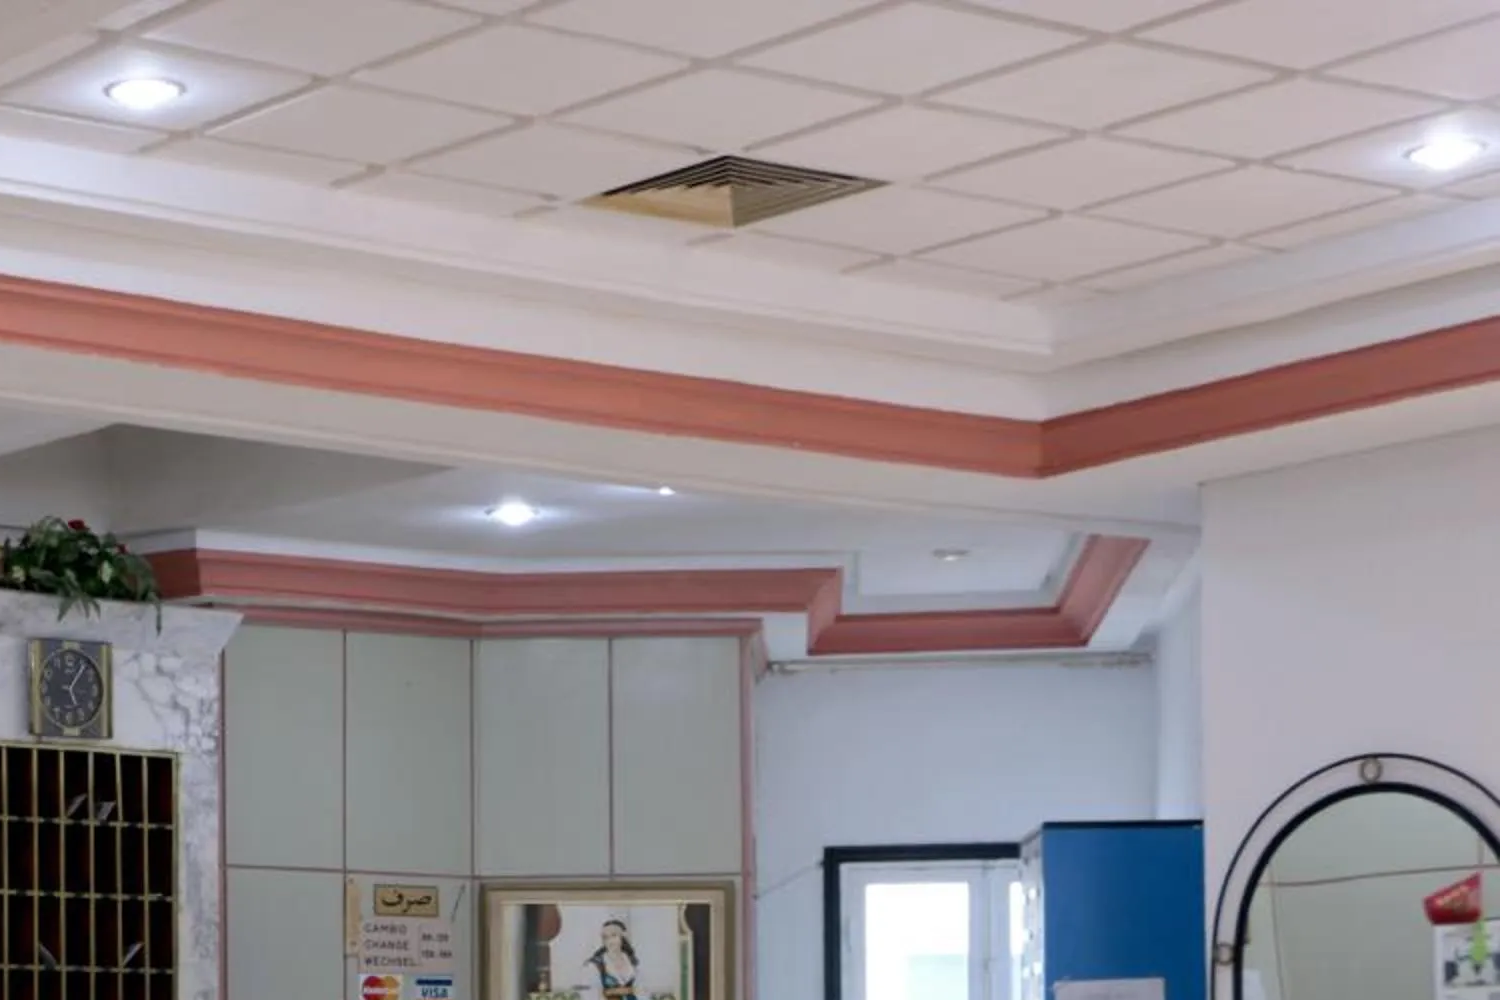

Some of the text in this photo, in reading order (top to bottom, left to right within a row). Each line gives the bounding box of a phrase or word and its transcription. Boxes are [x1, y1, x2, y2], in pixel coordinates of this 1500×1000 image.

[380, 888, 433, 914] صرف
[363, 922, 408, 936] CAMBIO
[363, 938, 410, 952] CHANGE
[420, 986, 449, 999] VISA
